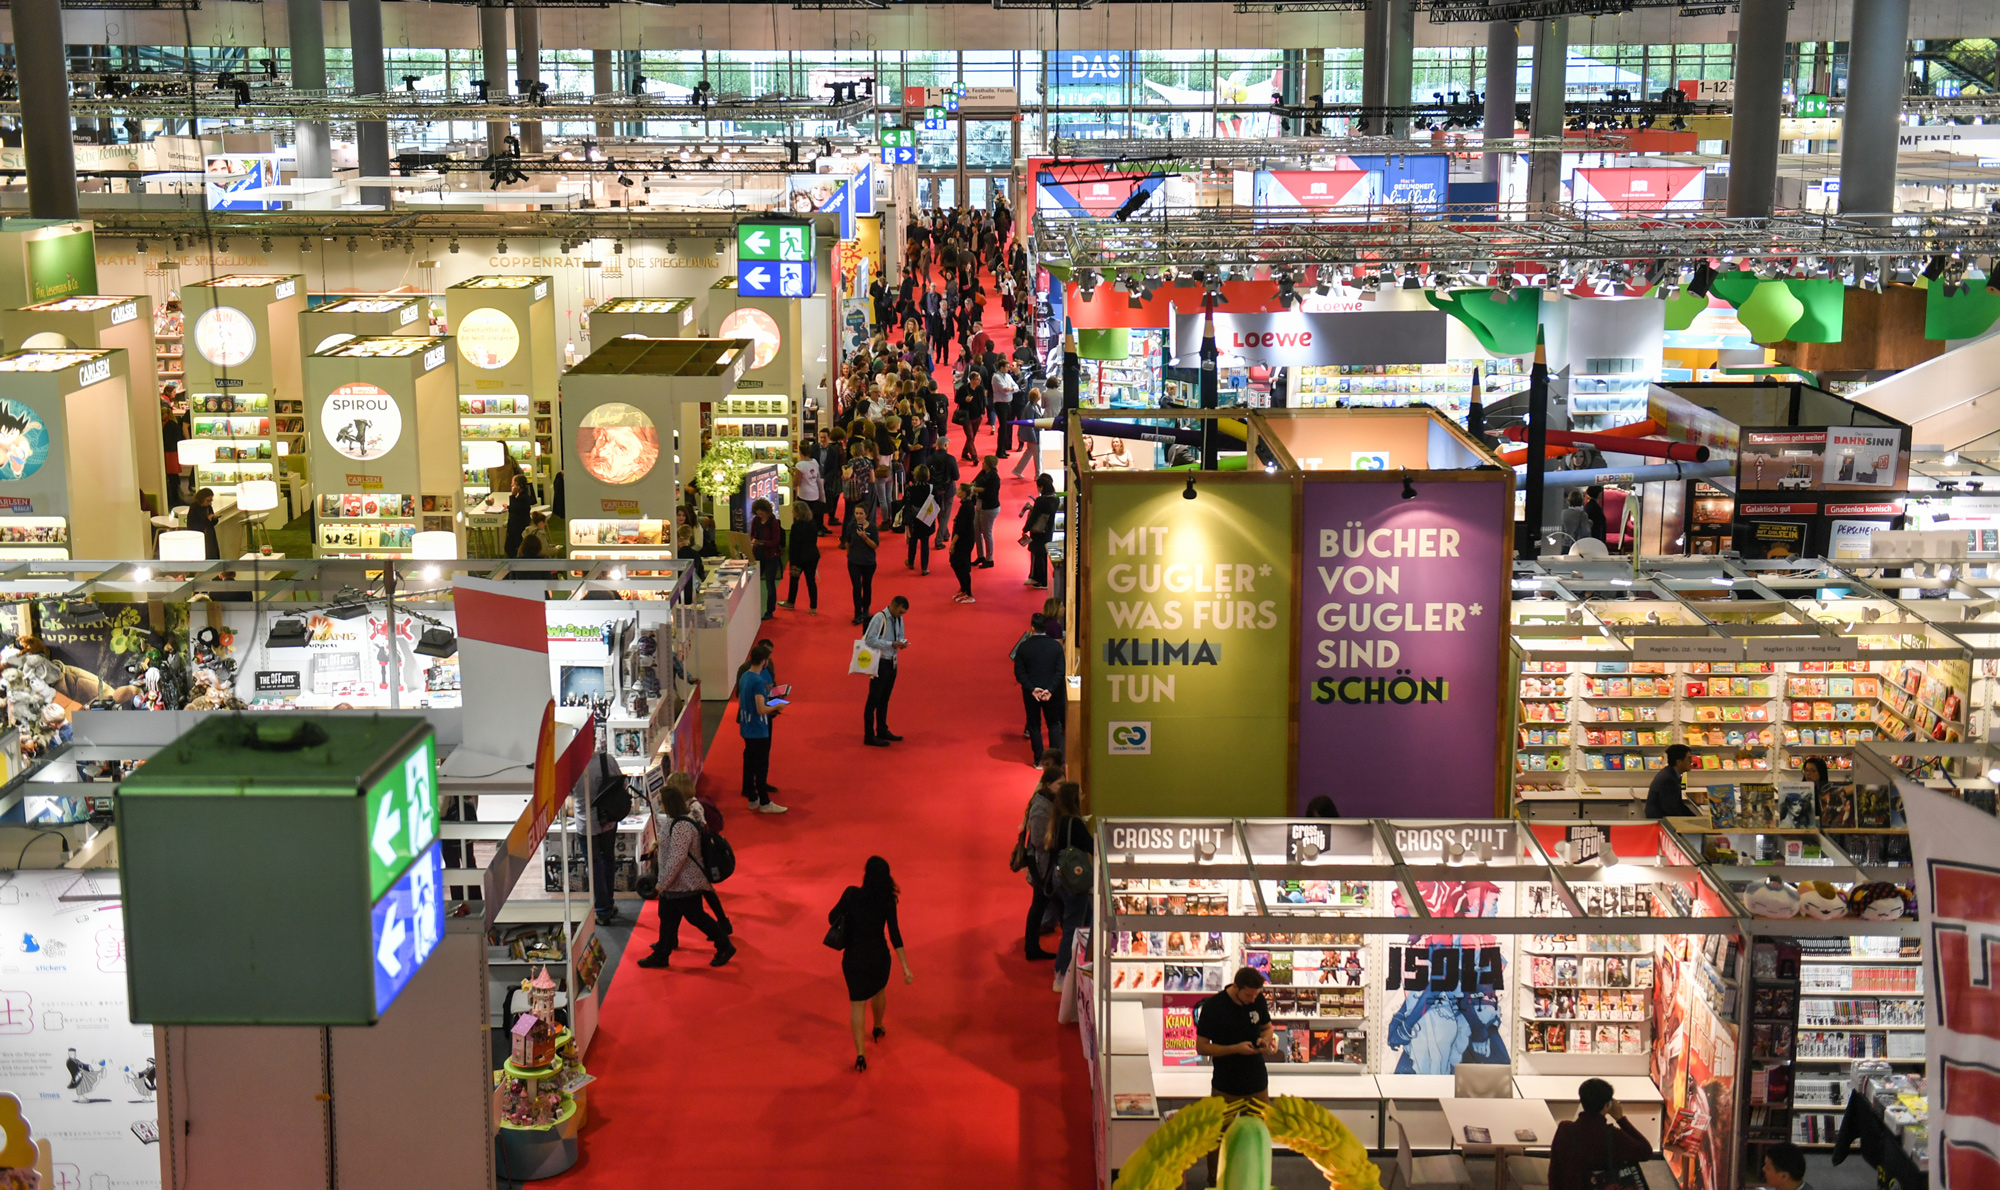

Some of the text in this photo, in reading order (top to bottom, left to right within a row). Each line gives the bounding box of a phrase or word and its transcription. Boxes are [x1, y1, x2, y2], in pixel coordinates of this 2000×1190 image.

[1072, 55, 1120, 78] DAS
[627, 257, 645, 269] DIE
[649, 257, 720, 269] SPIEGELBURG
[111, 303, 138, 325] CARLSEN
[79, 358, 111, 387] CARLSEN
[333, 400, 388, 410] SPIROU
[1791, 435, 1804, 443] geht
[1806, 434, 1825, 442] weiter!
[1834, 436, 1893, 447] BAHNSINN
[347, 475, 380, 485] CARLSEN
[749, 475, 779, 499] GREG
[0, 498, 28, 506] ARLSEN
[602, 500, 636, 510] CARLSEN
[1780, 506, 1791, 514] gut
[1830, 504, 1892, 513] Gnadenlos komisch
[1108, 526, 1168, 556] MIT
[1319, 520, 1460, 558] BÜCHER
[1318, 565, 1400, 595] VON
[1107, 592, 1278, 630] WAS FÜRS
[547, 623, 600, 637] Wrebbit
[1107, 638, 1218, 666] KLIMA
[1316, 639, 1400, 669] SIND
[259, 672, 295, 685] THE OFF BITS
[1107, 674, 1175, 703] TUN
[1316, 668, 1444, 705] SCHÖN
[1113, 828, 1225, 849] CROSS CULT
[1395, 829, 1508, 851] CROSS CULT
[1571, 826, 1598, 839] manga
[1165, 1015, 1192, 1029] KEANU
